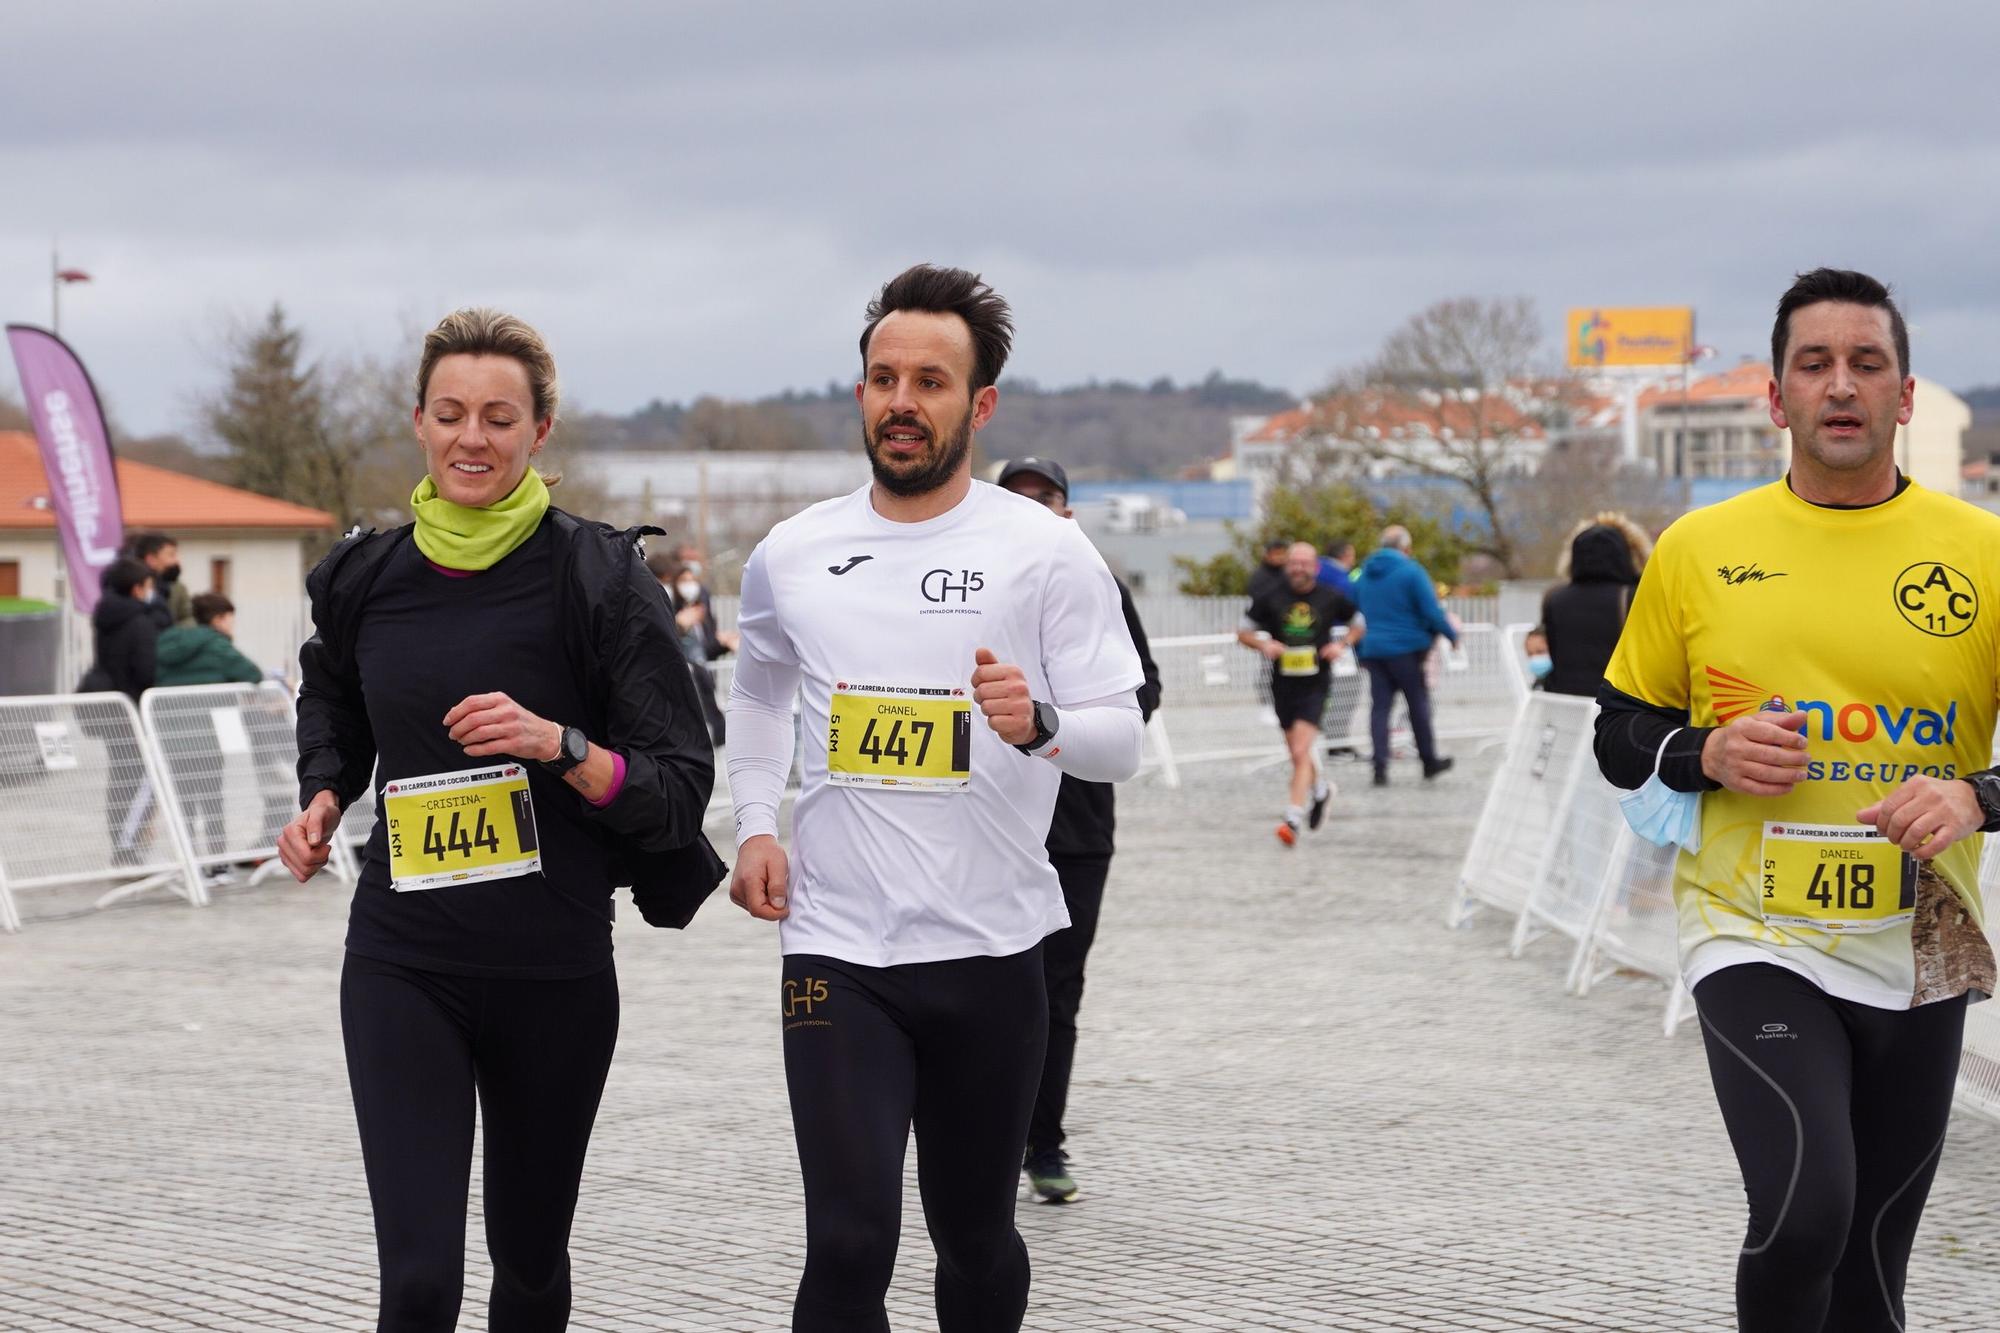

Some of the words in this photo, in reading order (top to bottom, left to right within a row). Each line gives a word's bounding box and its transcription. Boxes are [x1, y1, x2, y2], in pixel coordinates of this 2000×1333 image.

[1925, 613, 1946, 632] 11
[858, 684, 886, 693] CARREIRA
[896, 687, 918, 695] COCIDO
[877, 705, 917, 716] CHANEL
[831, 715, 840, 724] 5
[830, 729, 840, 752] KM
[859, 718, 934, 767] 447
[1807, 761, 1956, 782] SEGUROS
[408, 780, 437, 791] CARREIRA
[447, 776, 470, 785] COCIDO
[390, 819, 399, 828] 5
[423, 807, 499, 861] 444
[1796, 829, 1828, 837] CARREIRA
[391, 833, 403, 858] KM
[1820, 849, 1864, 860] DANIEL
[1764, 859, 1775, 869] 5
[1764, 874, 1775, 898] KM
[1806, 863, 1875, 909] 418
